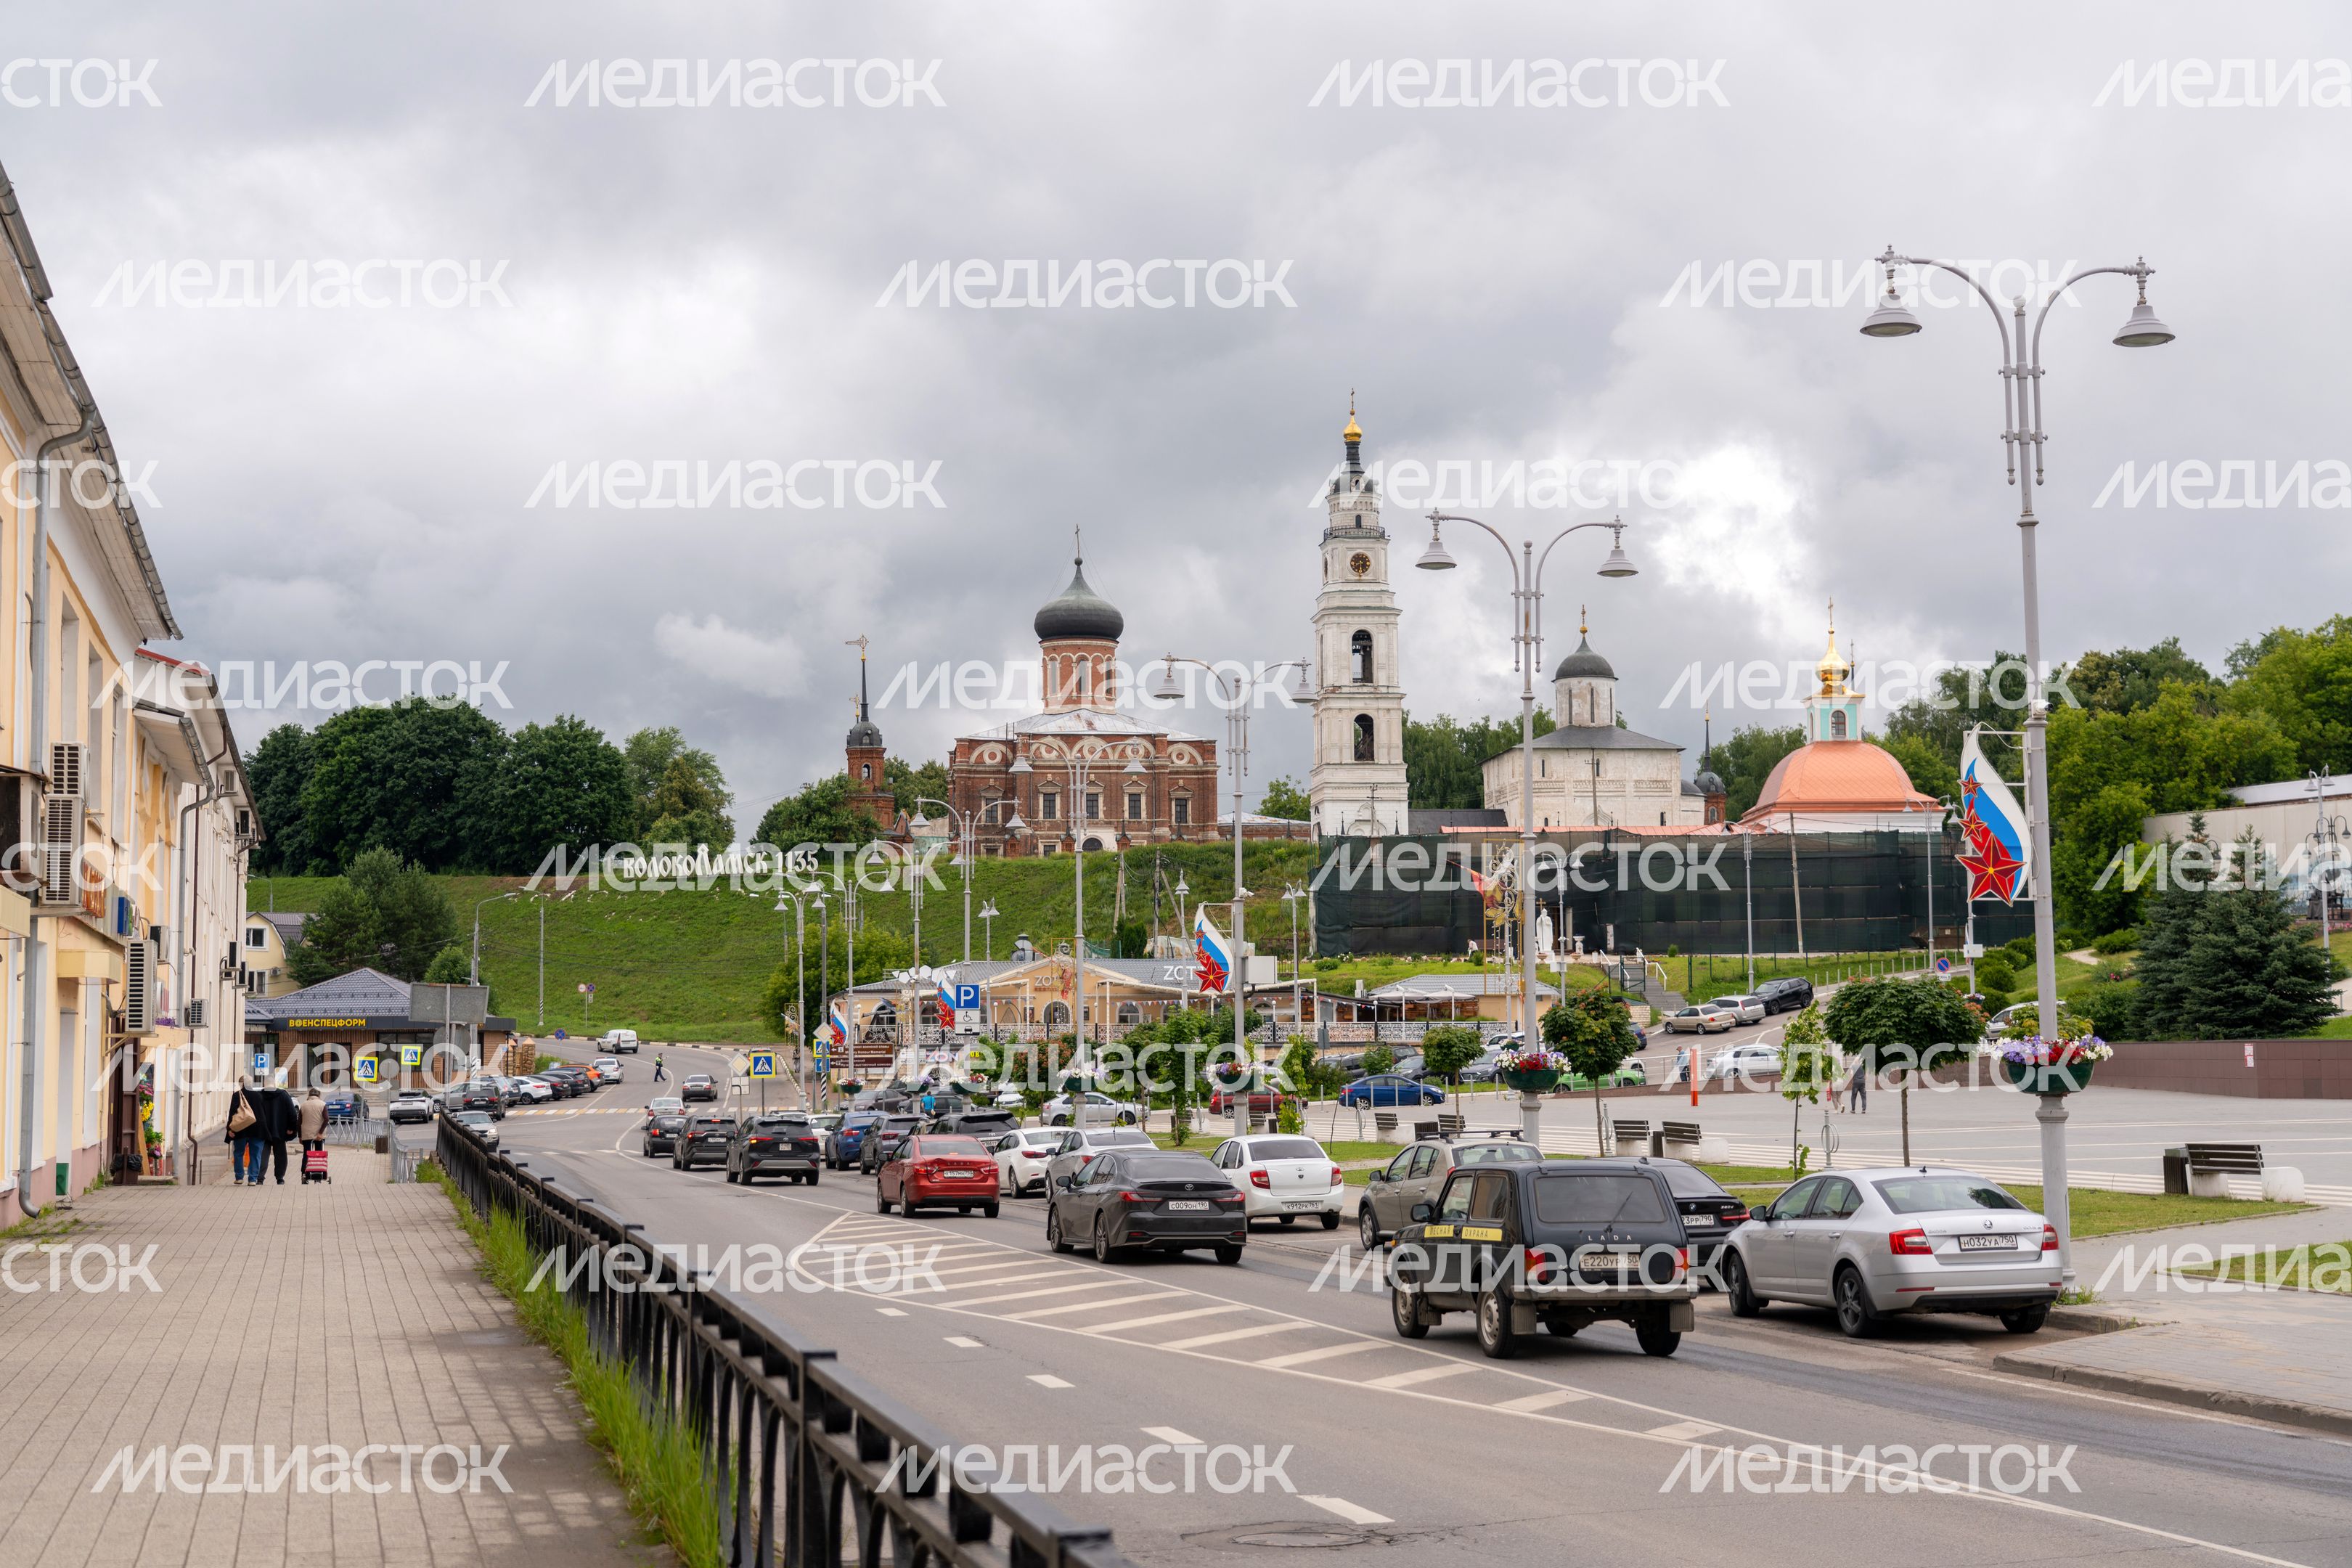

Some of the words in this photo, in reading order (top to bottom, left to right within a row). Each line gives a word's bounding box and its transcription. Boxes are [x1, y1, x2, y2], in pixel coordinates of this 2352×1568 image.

[775, 850, 819, 873] 1135
[960, 987, 974, 1007] P
[289, 1018, 366, 1028] ВОЕНСПЕЦФОРМ
[1464, 1228, 1488, 1237] ОХРАНА
[1964, 1236, 1999, 1247] Н032УА
